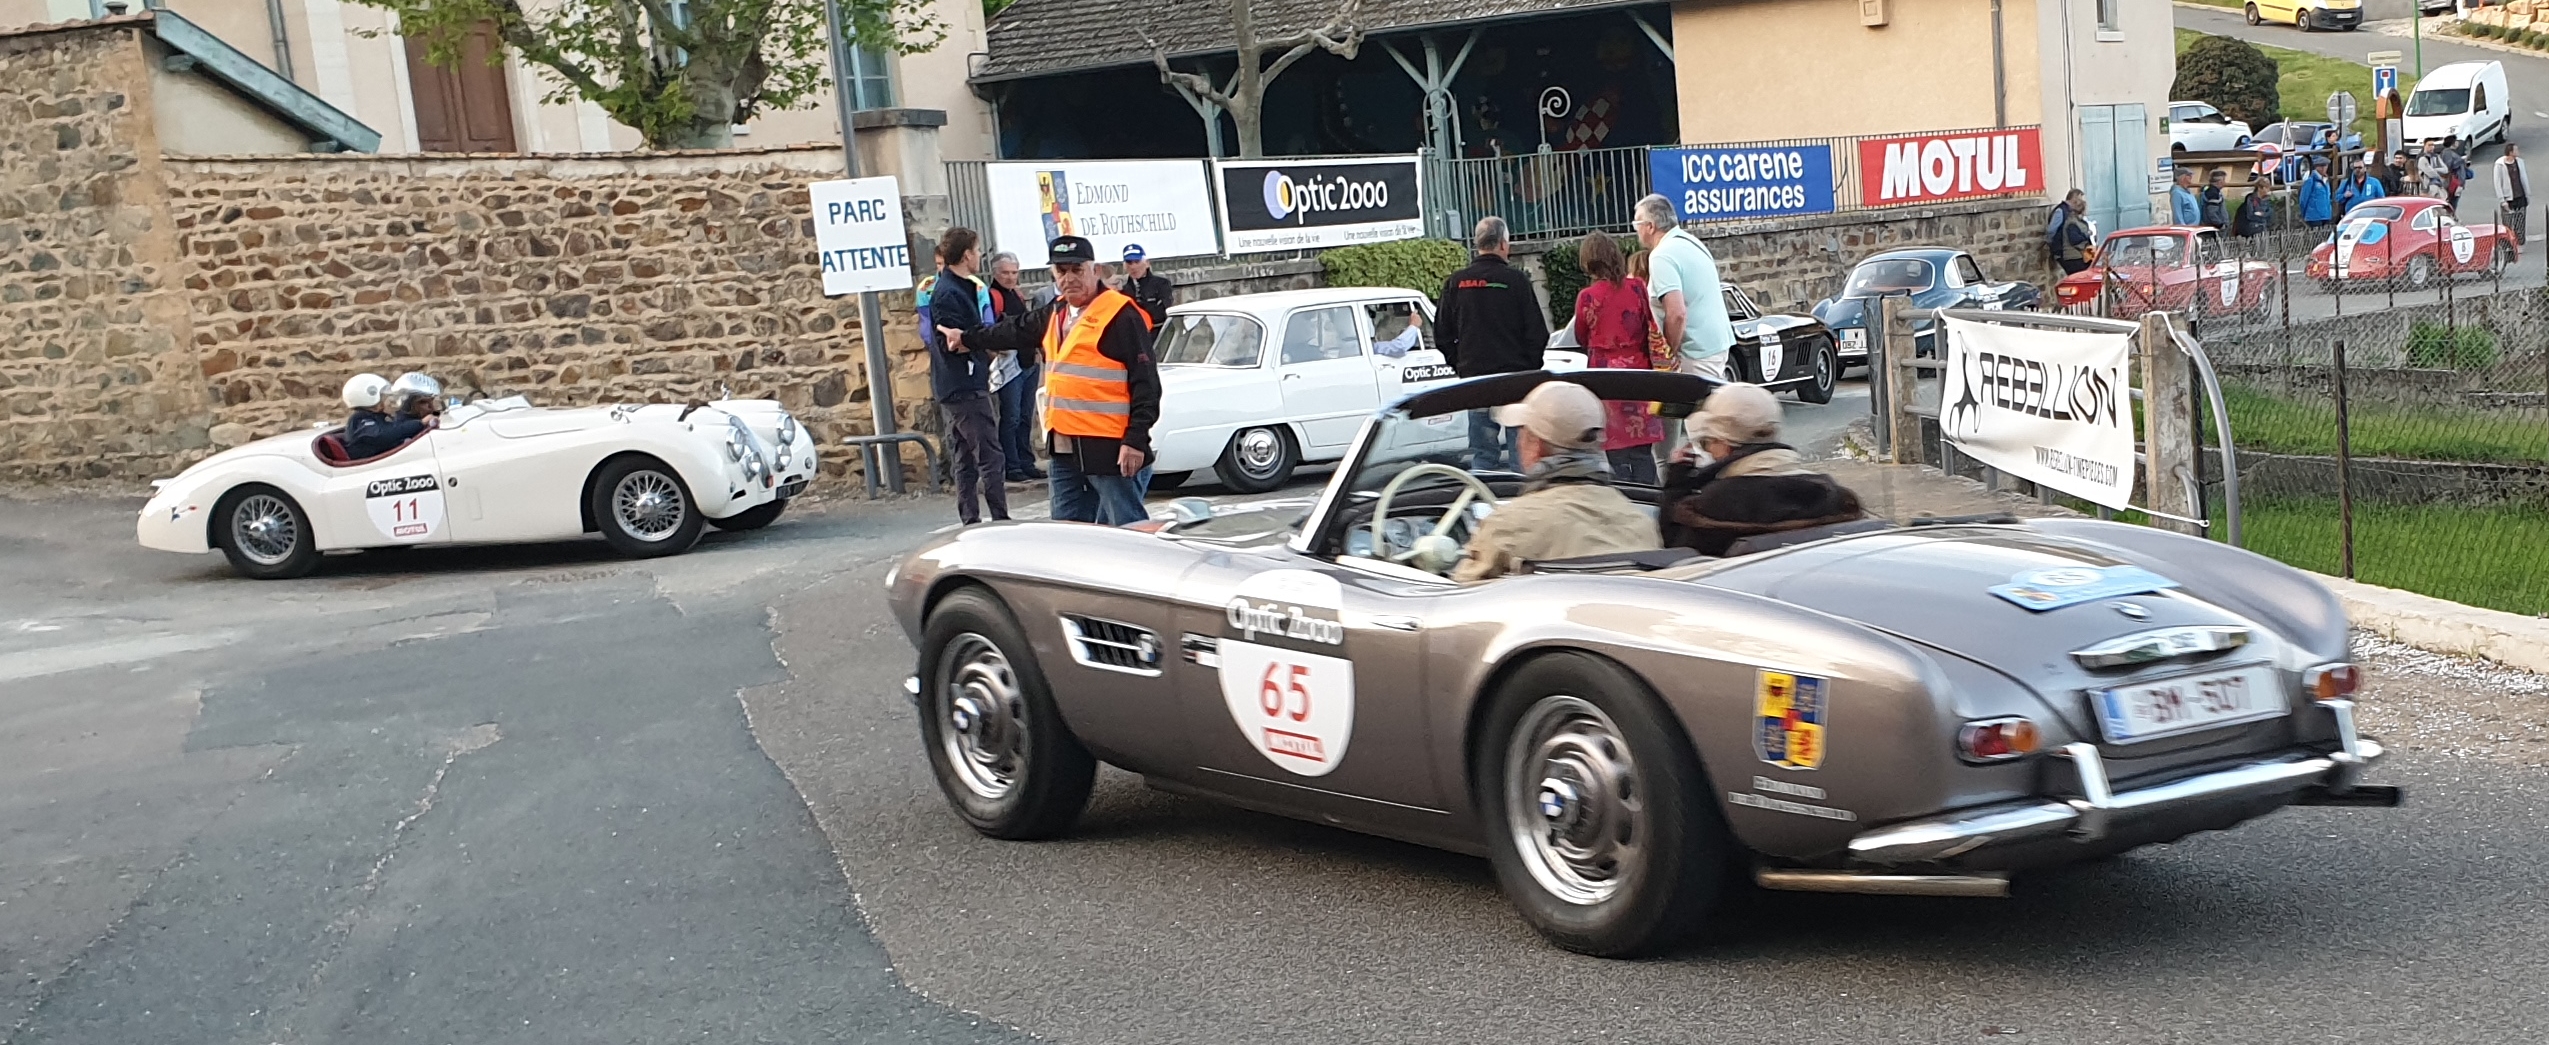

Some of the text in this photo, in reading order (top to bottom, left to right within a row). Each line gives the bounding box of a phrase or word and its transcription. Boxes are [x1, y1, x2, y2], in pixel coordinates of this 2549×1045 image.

[1682, 151, 1803, 184] ICC carene
[1881, 134, 2027, 200] MOTUL
[1075, 182, 1129, 205] EDMOND
[1684, 184, 1805, 214] assurances
[828, 199, 886, 225] PARC
[1080, 211, 1177, 236] DE ROTHSCHILD
[821, 244, 911, 274] ATTENTE
[1404, 365, 1431, 382] Optic
[1979, 351, 2118, 429] REBELLION
[370, 477, 435, 497] Optic 2000
[393, 498, 417, 522] 11
[1259, 660, 1313, 723] 65
